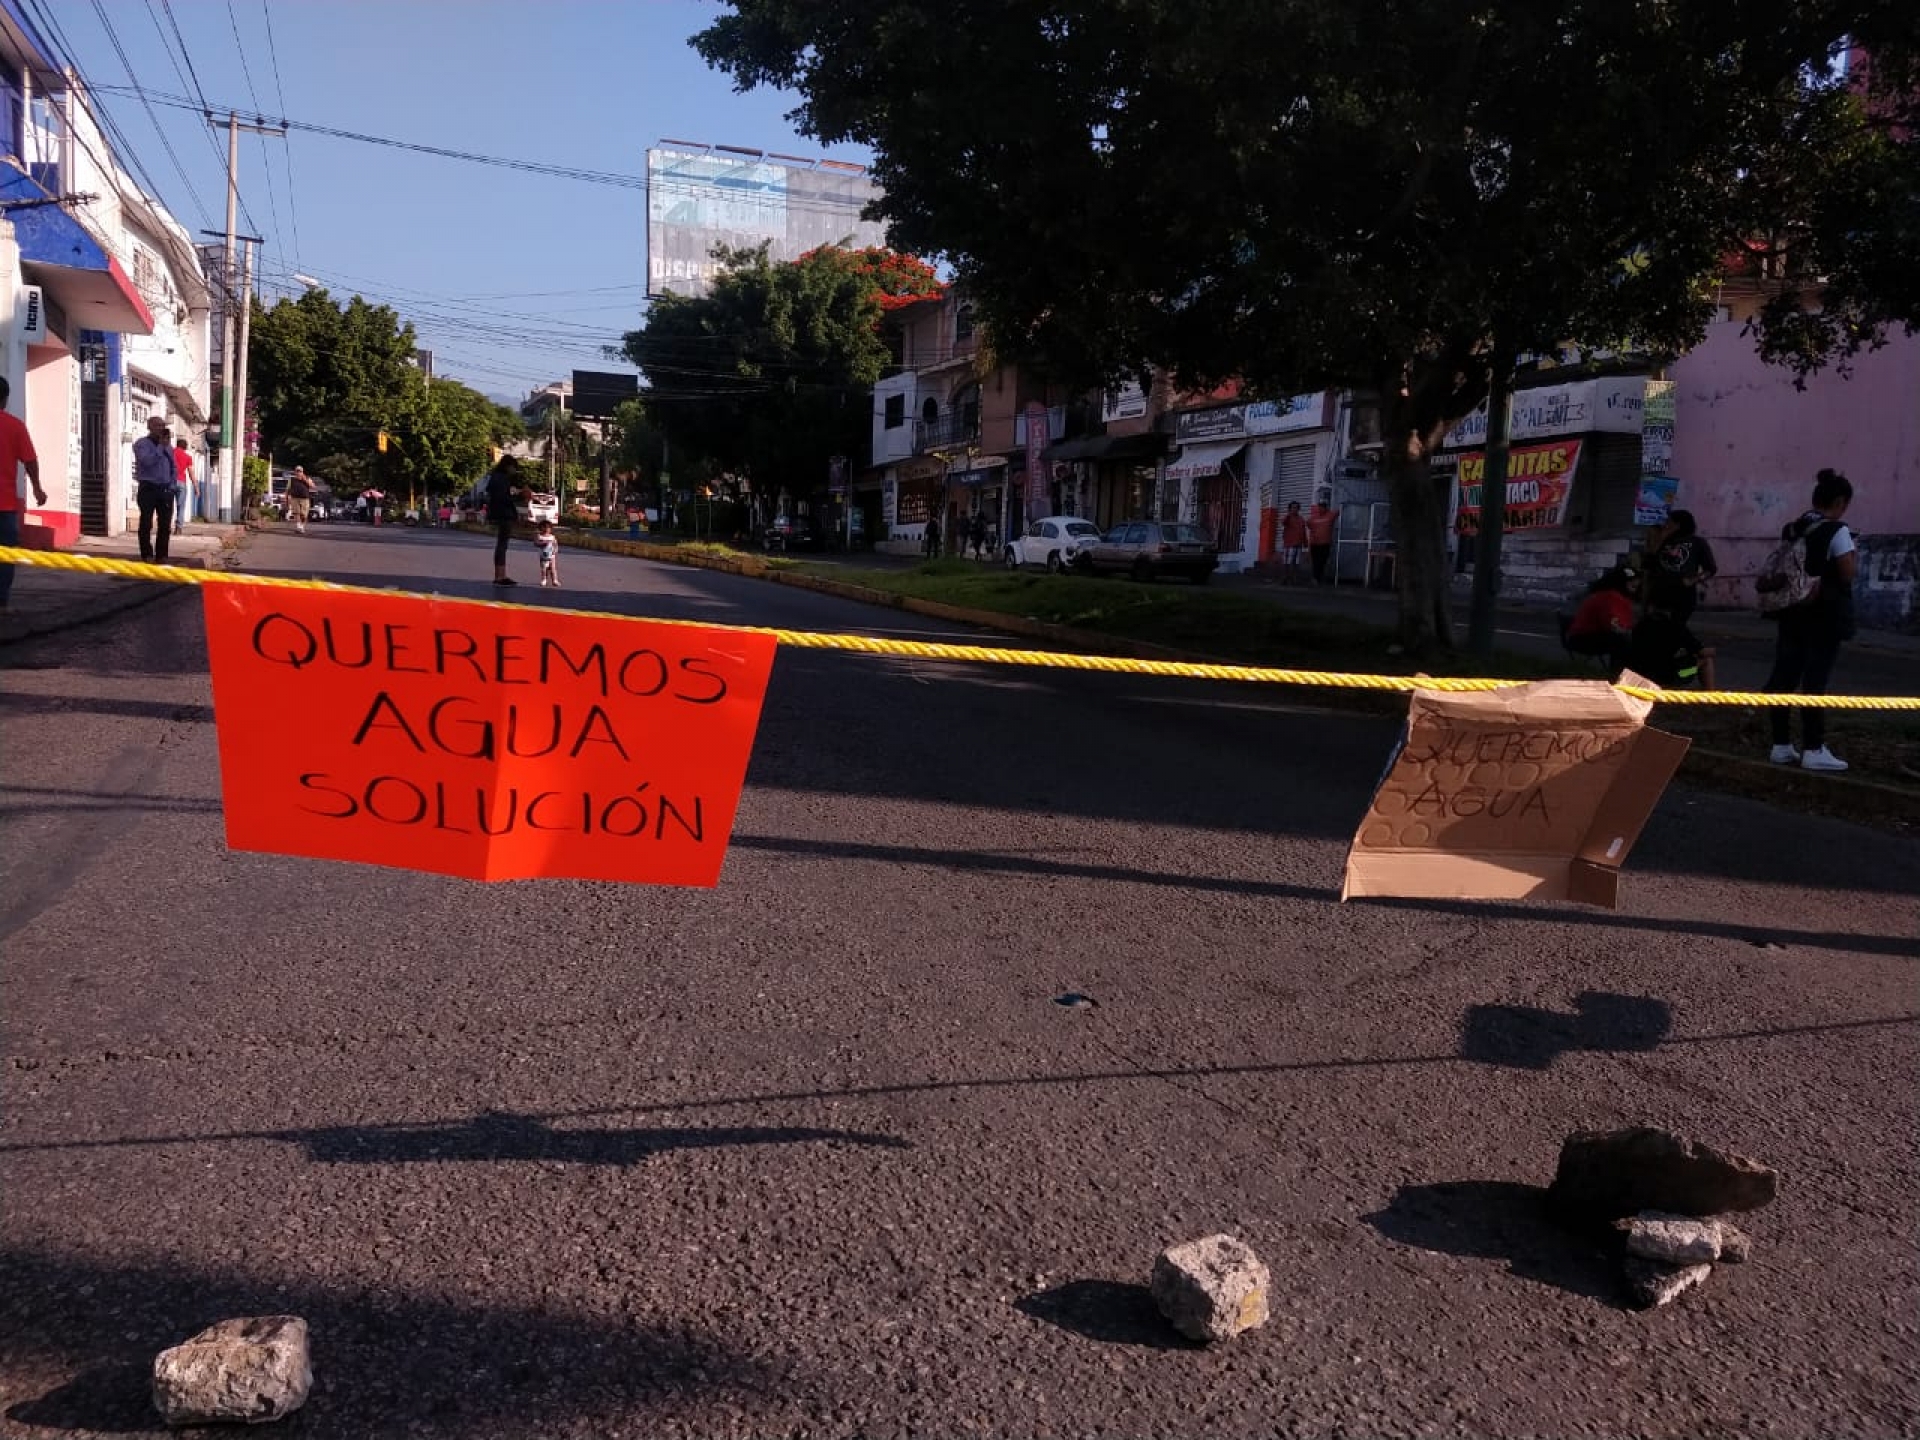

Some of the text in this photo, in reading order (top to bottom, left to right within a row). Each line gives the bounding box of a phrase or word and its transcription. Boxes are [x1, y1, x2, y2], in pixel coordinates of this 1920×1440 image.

[1506, 480, 1540, 505] TACO
[252, 613, 728, 704] QUEREMOS
[352, 692, 630, 761] AGUA
[299, 772, 704, 843] SOLUCIÓN
[1407, 780, 1550, 827] AGUA
